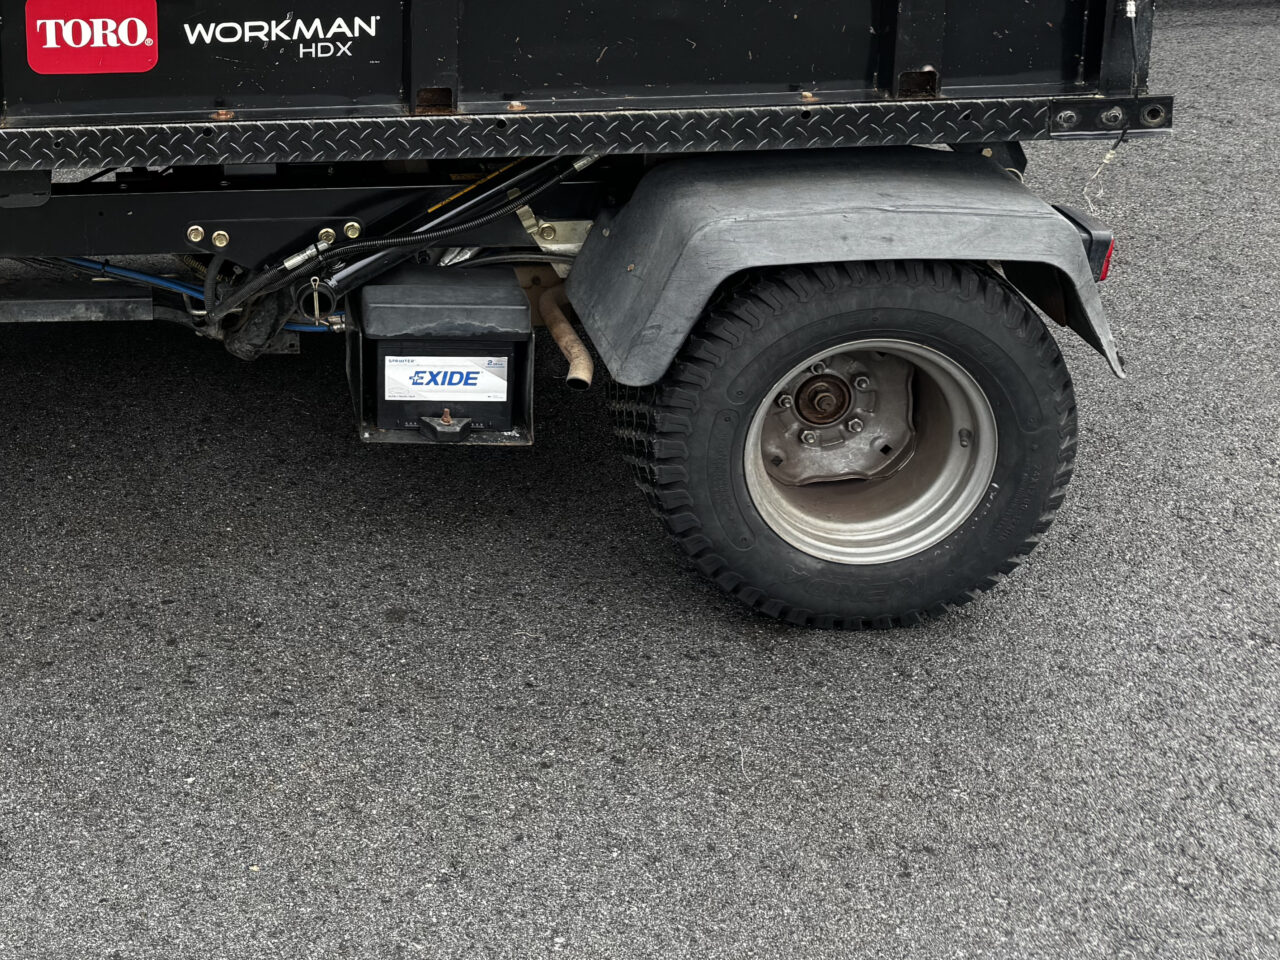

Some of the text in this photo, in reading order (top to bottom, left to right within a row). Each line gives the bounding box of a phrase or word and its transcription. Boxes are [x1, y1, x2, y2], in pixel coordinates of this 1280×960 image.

[36, 17, 148, 49] TORO
[183, 16, 378, 45] WORKMAN
[299, 41, 353, 58] HDX
[409, 370, 480, 387] EXIDE
